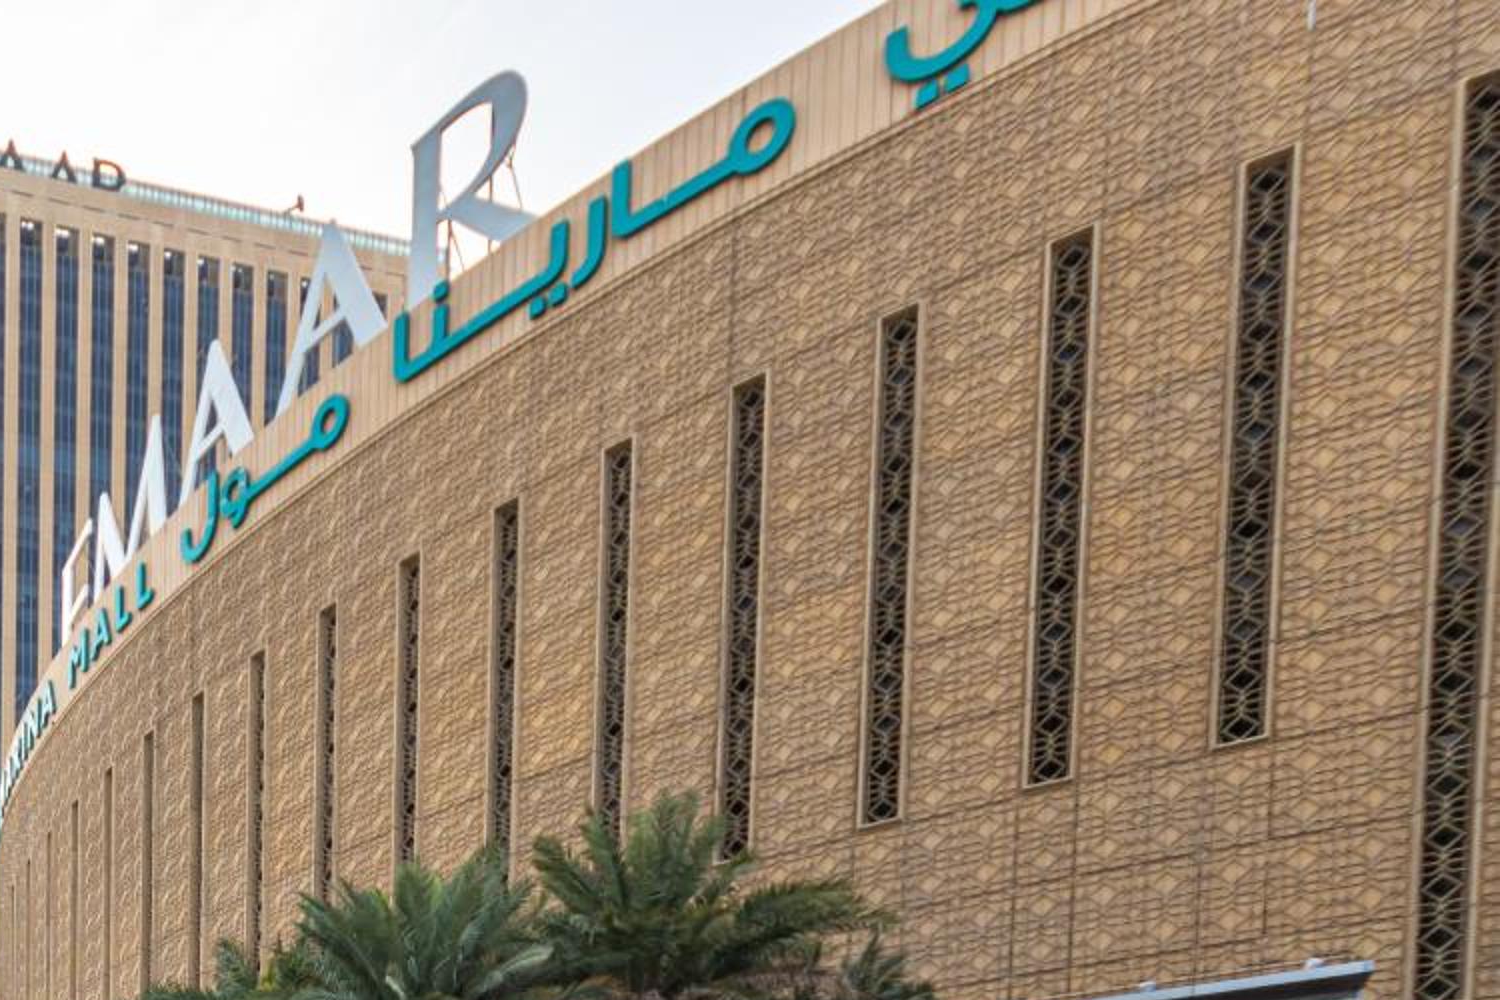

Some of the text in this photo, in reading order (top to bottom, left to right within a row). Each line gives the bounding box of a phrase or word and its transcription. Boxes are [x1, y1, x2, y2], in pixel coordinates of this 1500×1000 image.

[62, 69, 542, 650] EMAAR
[182, 96, 797, 563] مارينا مول
[68, 560, 155, 690] MALL
